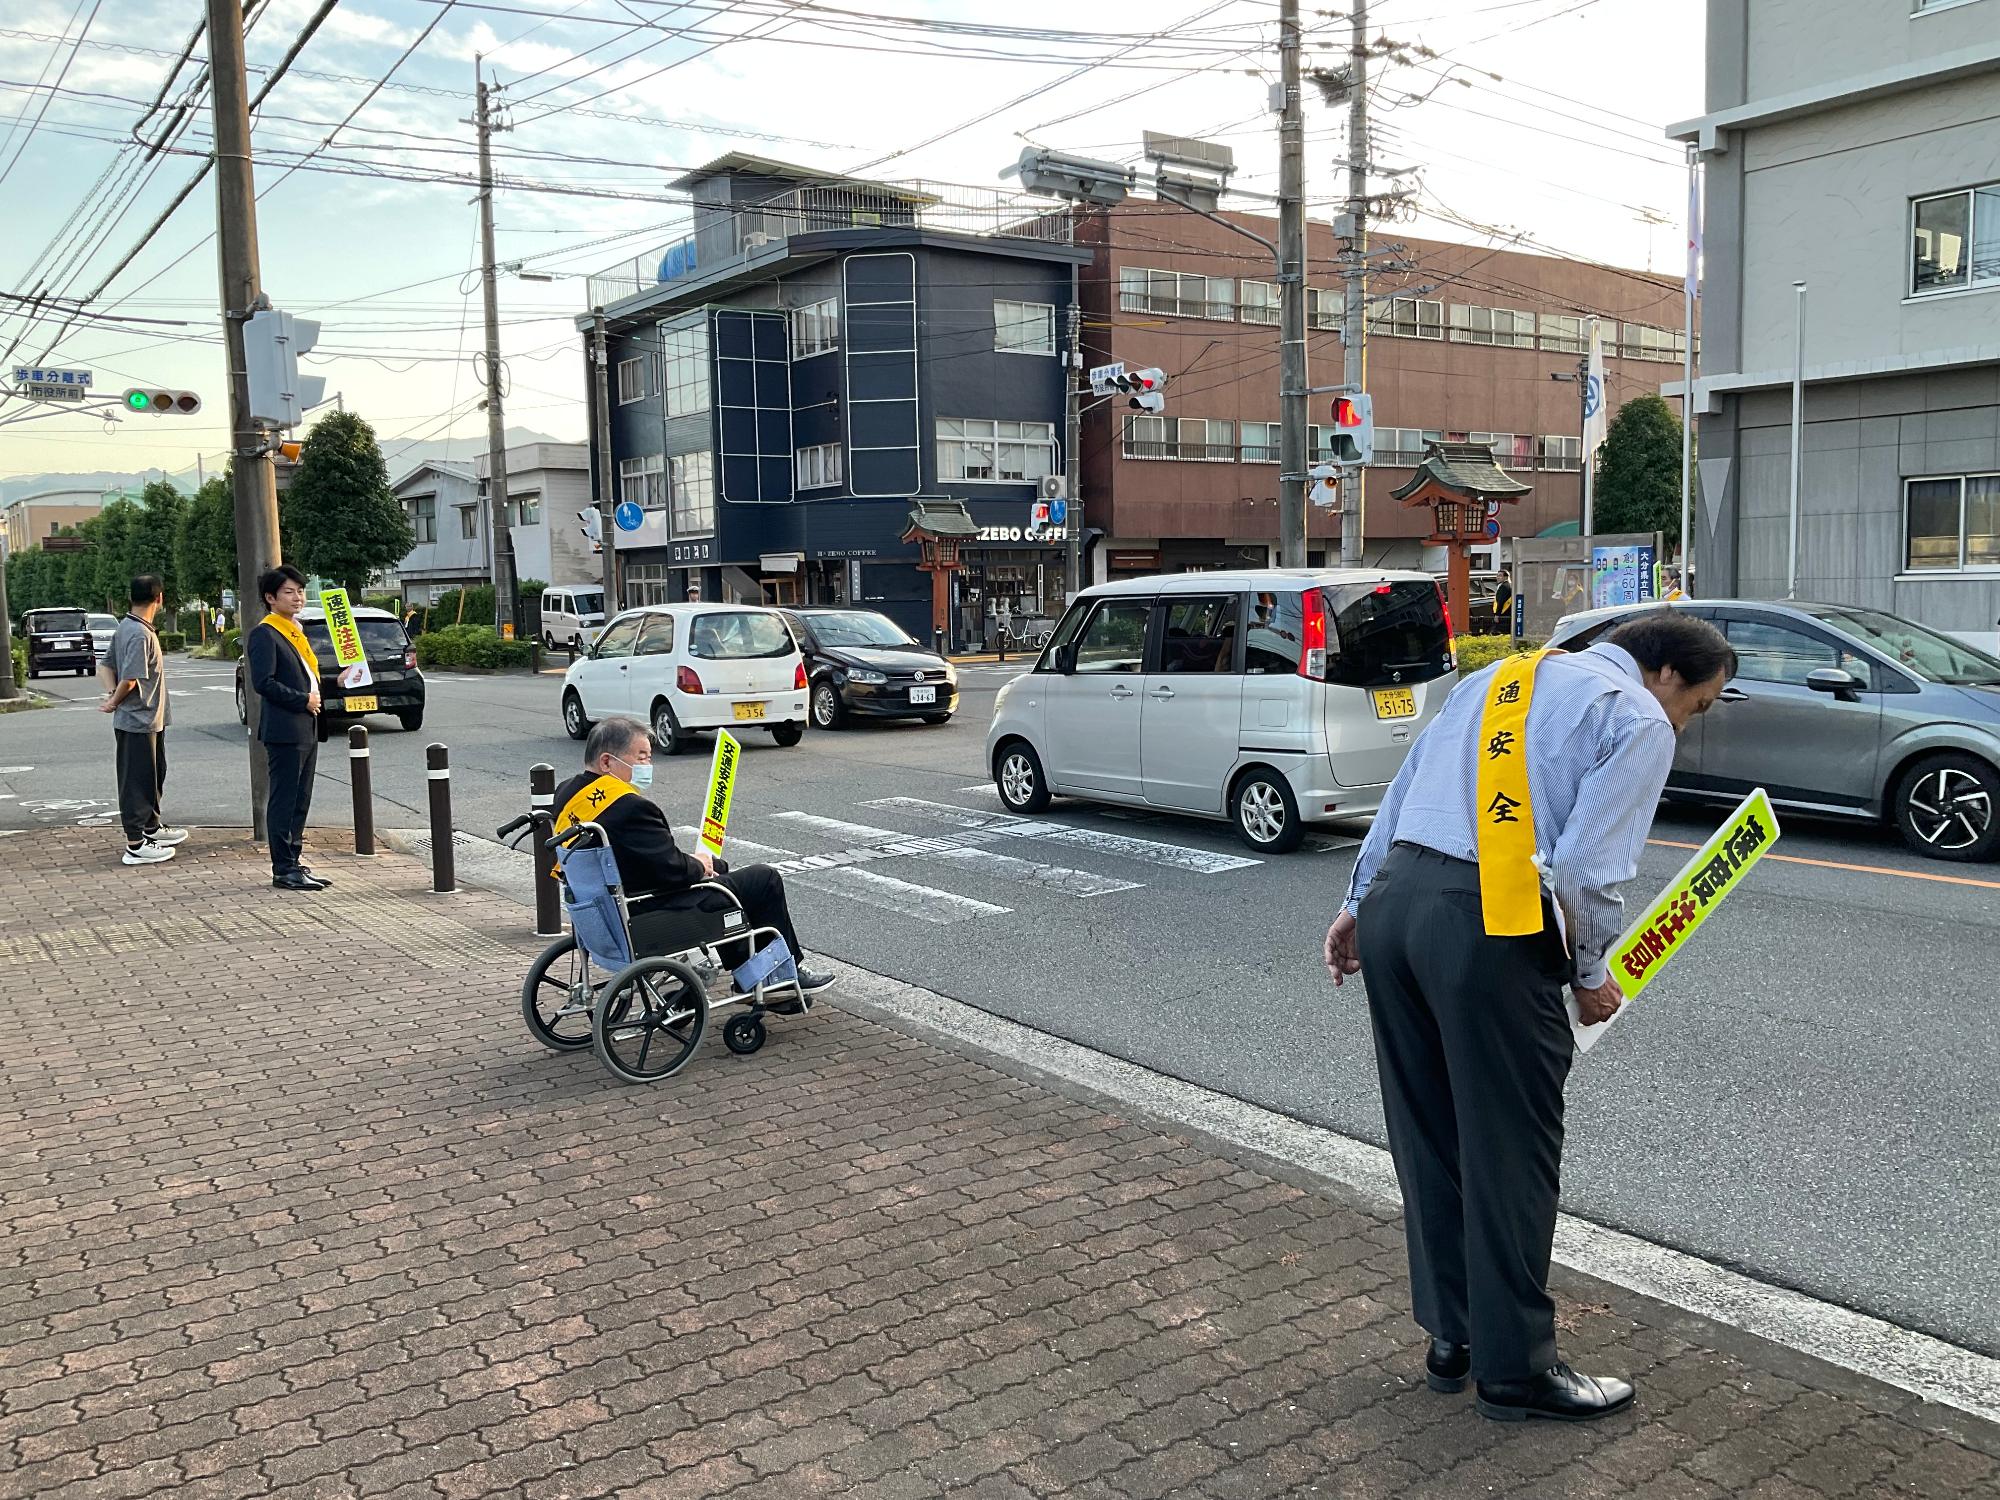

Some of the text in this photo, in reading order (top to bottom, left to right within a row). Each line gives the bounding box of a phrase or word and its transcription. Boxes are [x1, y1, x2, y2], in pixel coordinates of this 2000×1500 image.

[16, 369, 90, 384] 歩車分離式
[31, 386, 79, 399] 市役所前
[976, 527, 1021, 541] ZEBO
[326, 593, 359, 660] 速度注意
[711, 741, 736, 822] 交通安全運動
[1621, 814, 1767, 981] 速度注意
